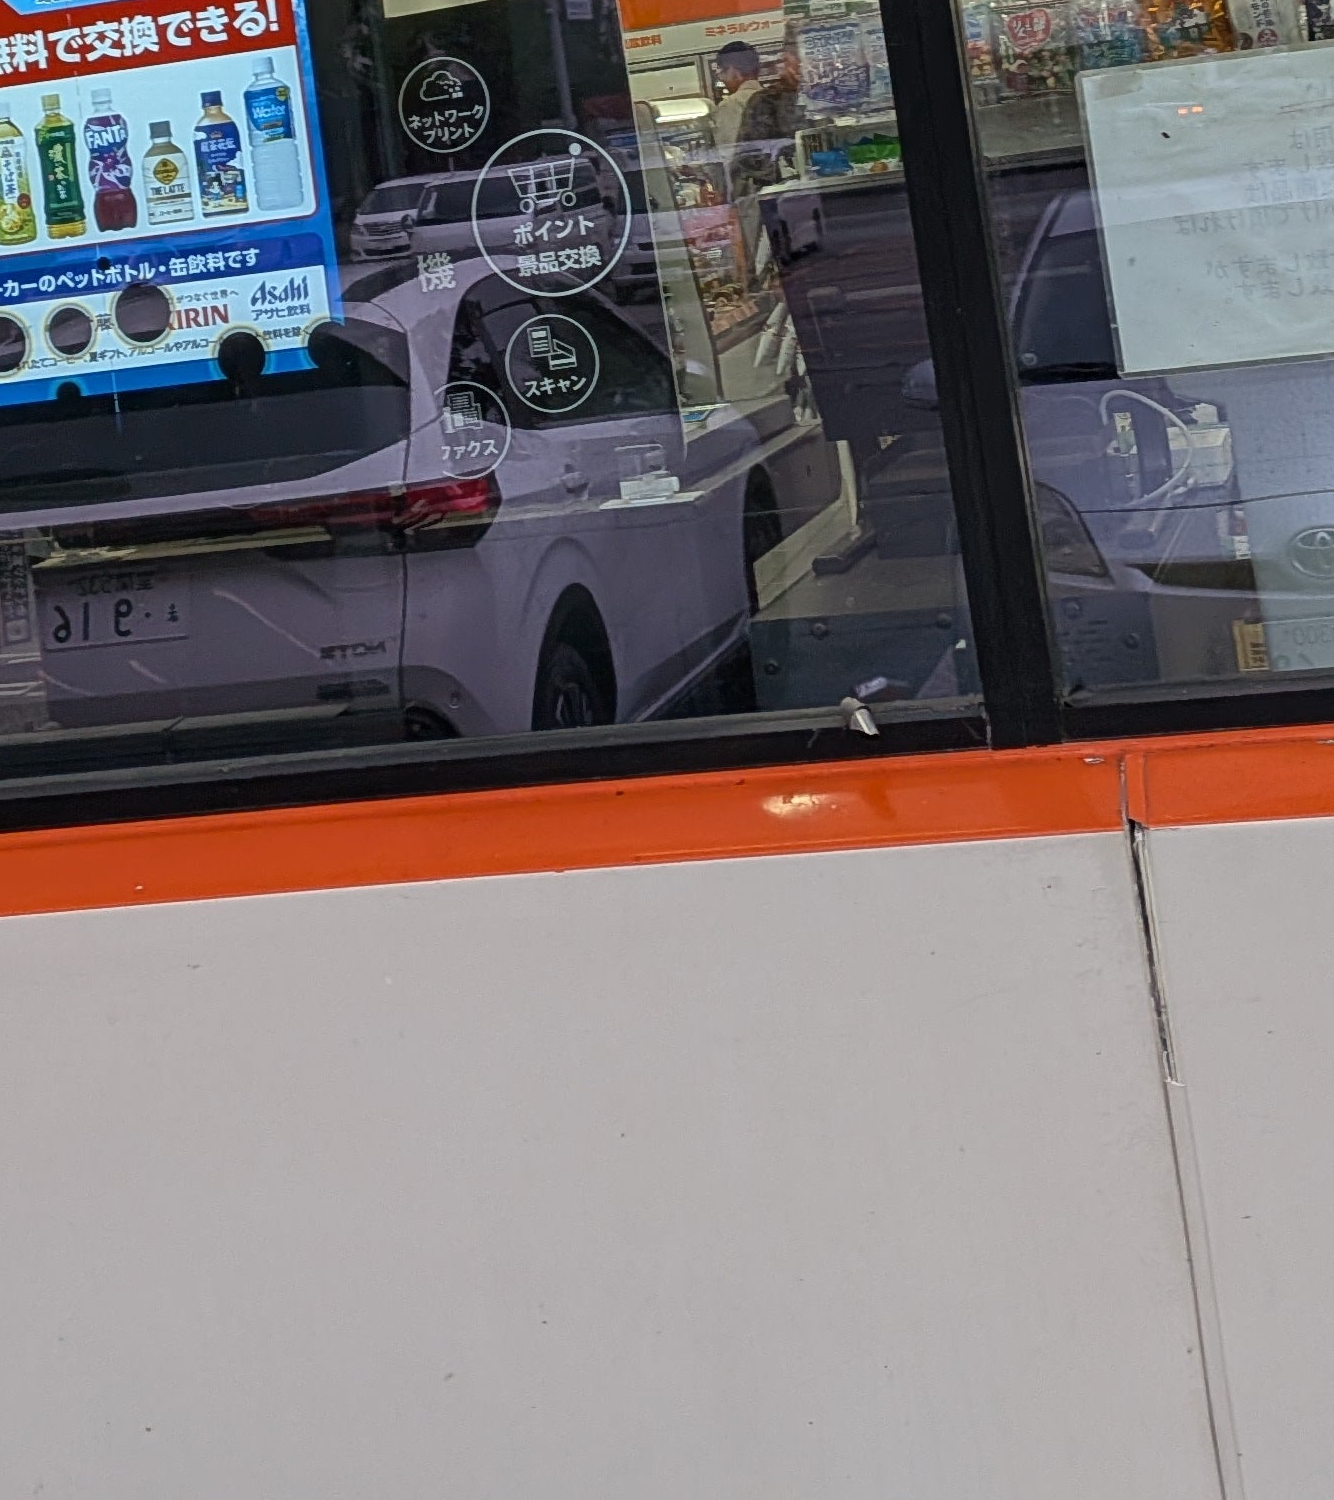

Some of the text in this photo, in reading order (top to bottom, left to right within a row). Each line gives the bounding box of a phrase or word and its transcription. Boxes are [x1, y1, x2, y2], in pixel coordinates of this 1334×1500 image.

[408, 104, 484, 130] ネットワーク
[423, 122, 475, 143] プリント
[513, 216, 595, 247] ポイント
[517, 245, 602, 278] 景品交換
[250, 275, 310, 307] Asahi
[169, 303, 229, 331] IRIN
[251, 303, 312, 322] アサヒ飲料
[524, 375, 587, 399] スキャン
[441, 440, 499, 461] ファクス
